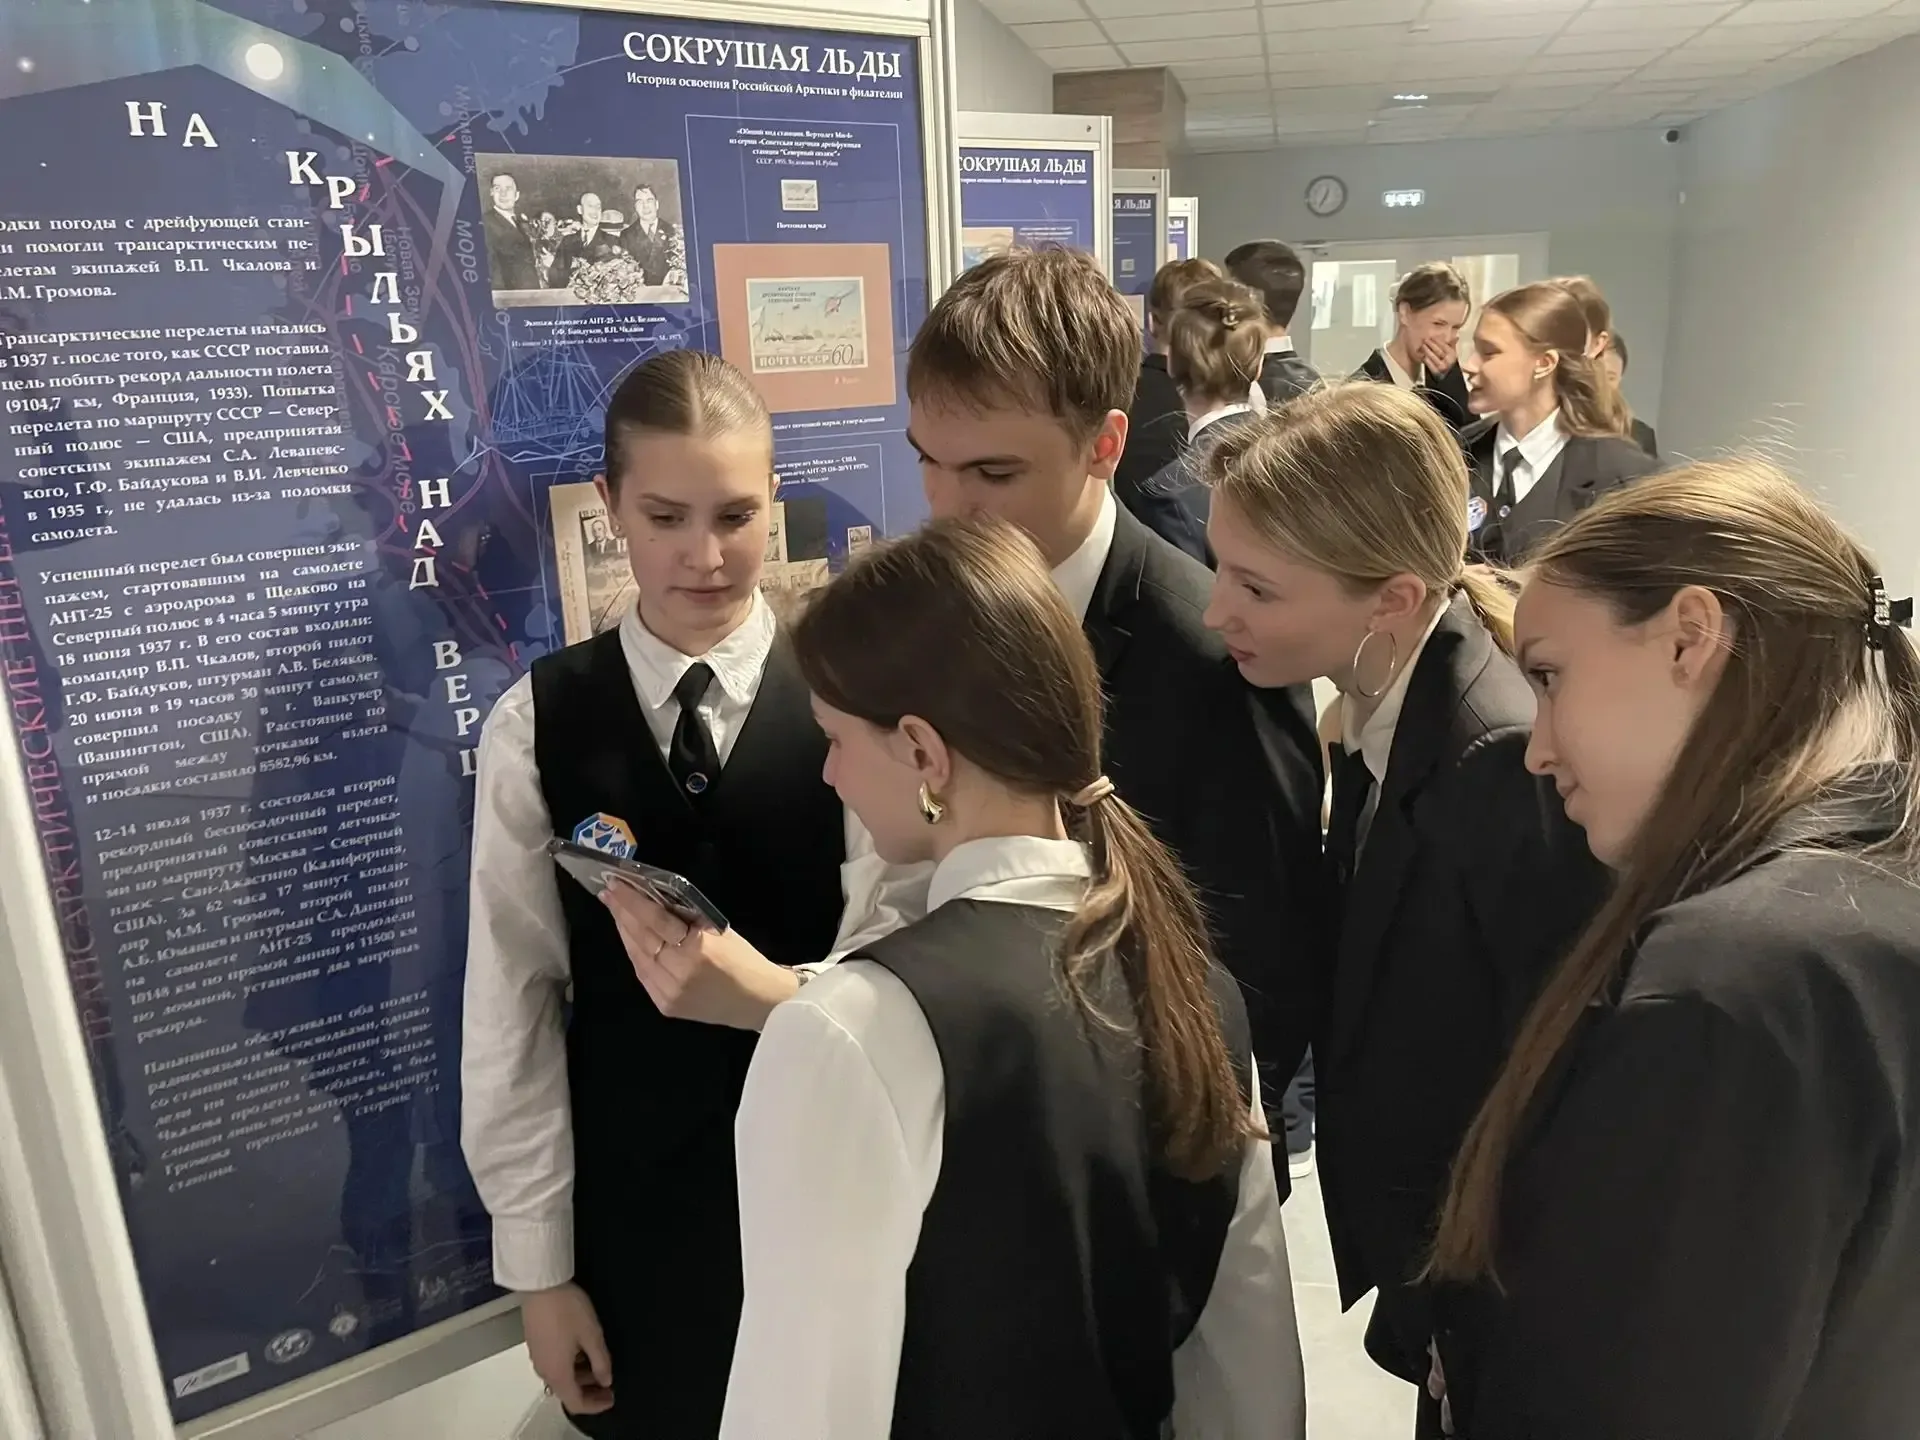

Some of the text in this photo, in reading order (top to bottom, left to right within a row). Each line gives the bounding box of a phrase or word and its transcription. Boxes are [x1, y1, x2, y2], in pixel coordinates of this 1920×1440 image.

[623, 31, 902, 82] СОКРУШАЯ ЛЬДЫ
[627, 71, 903, 100] История освоения Российской Арктики в филателии
[1044, 158, 1086, 176] ЛЬДЫ
[49, 219, 116, 230] погоды
[125, 218, 134, 228] с
[143, 215, 259, 232] дрейфующей
[267, 218, 310, 228] стан-
[25, 241, 104, 253] помогли
[114, 239, 277, 255] трансарктическим
[287, 239, 313, 250] пе-
[456, 219, 479, 284] море
[71, 260, 160, 275] экипажей
[175, 258, 209, 272] В.П.
[223, 258, 292, 271] Чкалова
[304, 260, 316, 270] и
[35, 284, 116, 302] Громова.
[125, 101, 218, 148] НА
[286, 151, 454, 420] КРЫЛЬЯХ
[409, 478, 452, 591] НАД
[164, 325, 247, 341] перелеты
[251, 323, 326, 335] начались
[10, 352, 47, 367] 1937
[52, 355, 66, 365] г.
[69, 352, 120, 364] после
[123, 350, 168, 362] того,
[171, 348, 201, 359] как
[203, 343, 250, 358] СССР
[255, 344, 329, 356] поставил
[832, 343, 854, 366] 60
[1, 364, 332, 391] цель побить рекорд дальности полета
[5, 384, 335, 413] (9104,7 км, Франция, 1933). Попытка
[9, 403, 339, 437] перелета по маршруту СССР Север-
[14, 425, 342, 456] ный полюс США, предпринятая
[18, 444, 345, 478] советским экипажем С.А. Леваневс-
[23, 464, 348, 499] кого, Г.Ф. Байдукова и В.И. Левченко
[27, 483, 351, 521] в 1935 г., не удалась из-за поломки
[31, 525, 118, 542] самолета.
[40, 541, 360, 584] Успешный перелет был совершен эки-
[44, 560, 363, 605] пажем, стартовавшим на самолете
[49, 578, 366, 626] АНТ-25 с аэродрома в Щелково на
[52, 597, 368, 646] Северный полюс в 4 часа 5 минут утра
